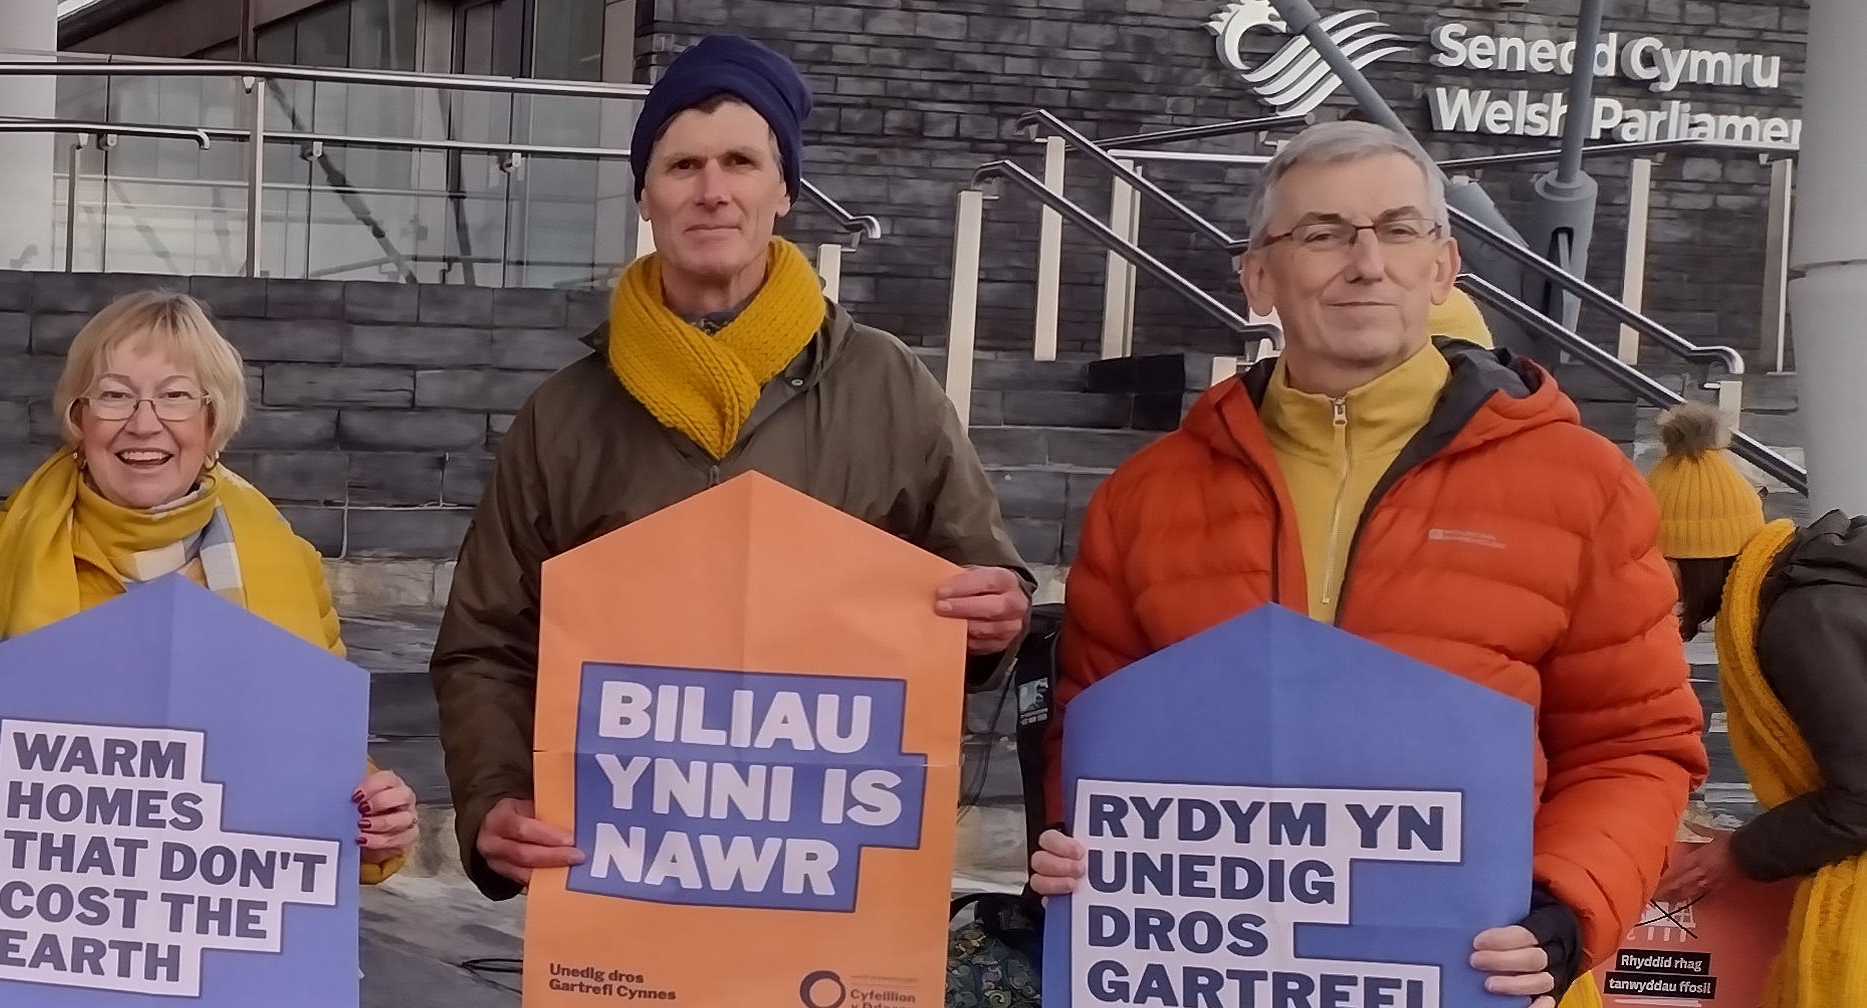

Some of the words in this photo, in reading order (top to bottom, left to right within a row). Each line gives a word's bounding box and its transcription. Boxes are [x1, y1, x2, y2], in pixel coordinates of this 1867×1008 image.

[1627, 36, 1781, 91] Cymru
[598, 681, 872, 753] BILIAU
[13, 731, 186, 780] WARM
[7, 781, 203, 831] HOMES
[594, 754, 794, 822] YNNI
[821, 768, 902, 826] IS
[1089, 794, 1327, 847] RYDYM
[1345, 804, 1444, 851] YN
[4, 830, 148, 877] THAT
[160, 841, 327, 892] DON'T
[590, 823, 839, 896] NAWR
[1087, 849, 1335, 904] UNEDIG
[161, 892, 268, 939] THE
[1088, 905, 1268, 957] DROS
[549, 962, 605, 982] Unedig
[608, 969, 644, 983] dros
[1609, 978, 1677, 993] tanwyddau
[1679, 981, 1711, 994] ffosil
[1621, 954, 1672, 969] Rhyddid
[1674, 958, 1703, 972] rhag
[549, 978, 613, 995] Gartrefi
[616, 985, 676, 1000] Cynnes
[850, 989, 916, 1003] Cyfeillion
